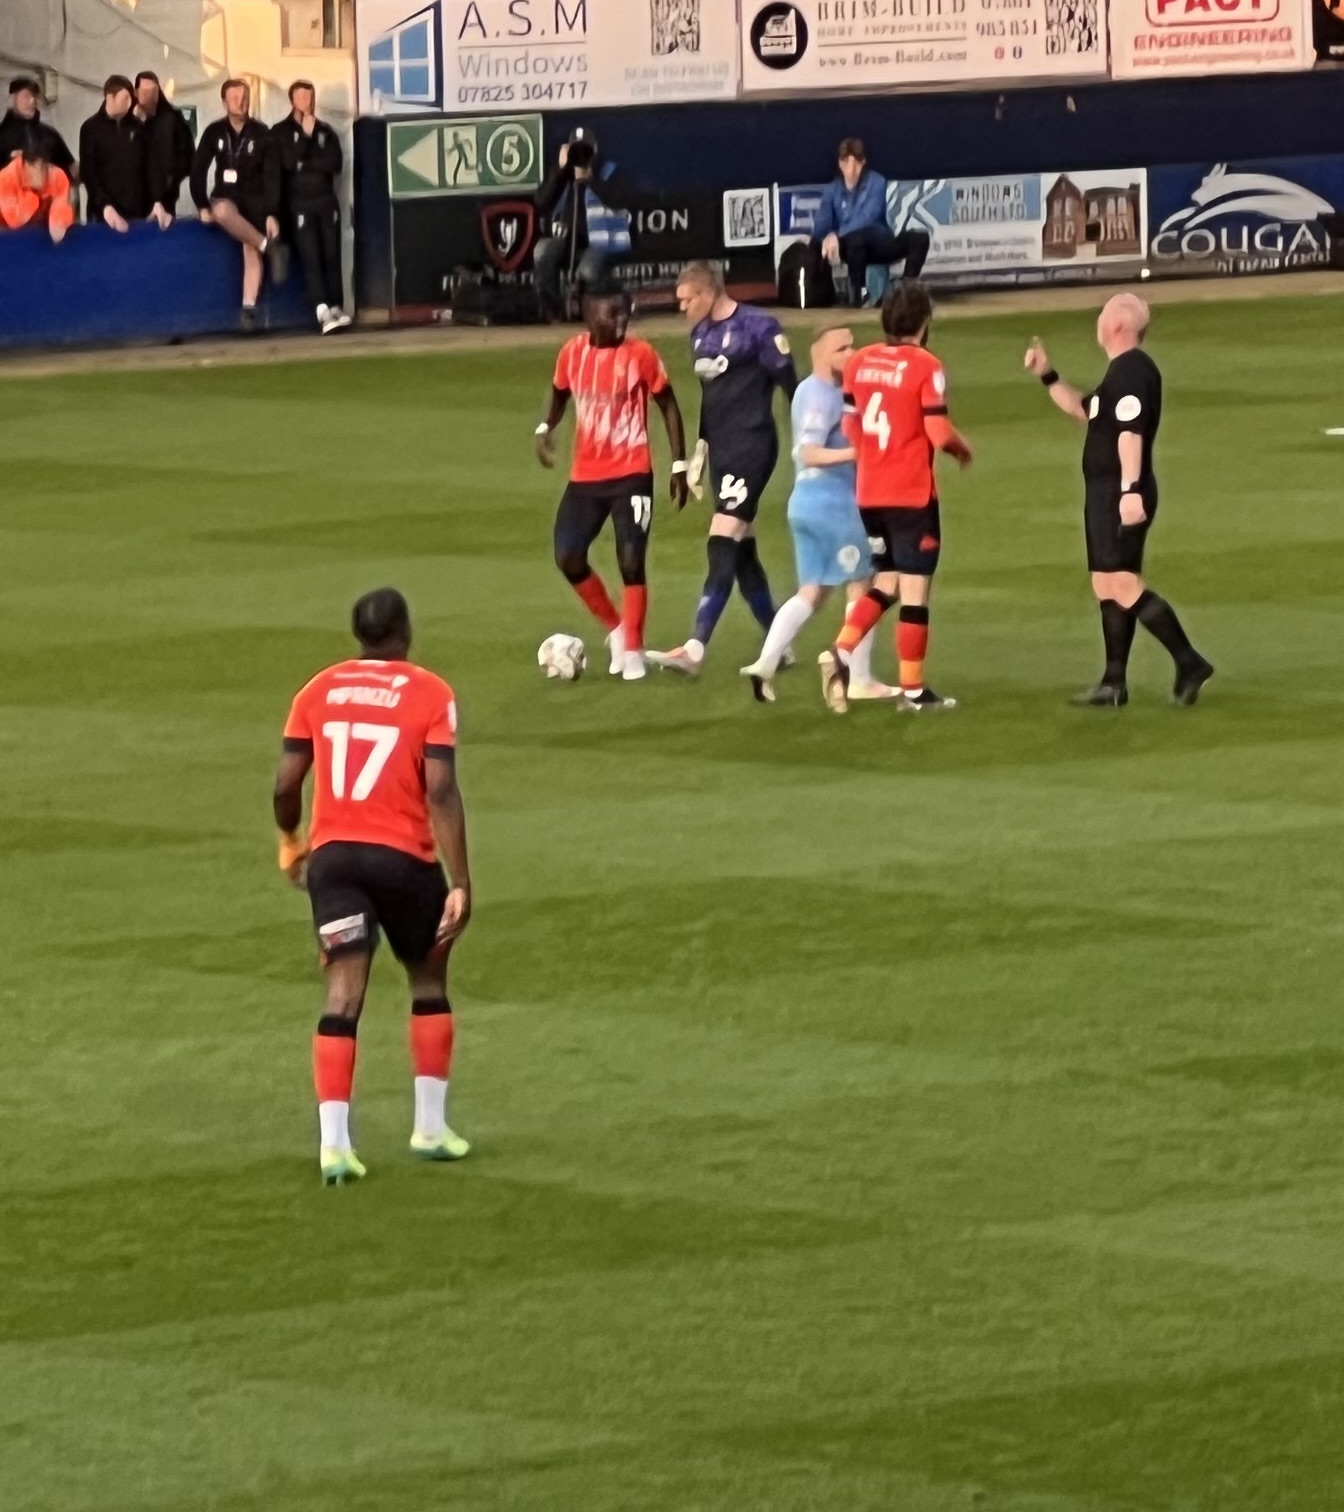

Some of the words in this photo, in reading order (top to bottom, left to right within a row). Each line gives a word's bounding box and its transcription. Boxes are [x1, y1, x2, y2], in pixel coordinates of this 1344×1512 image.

[458, 50, 588, 79] Windows
[501, 136, 522, 172] 5
[1151, 223, 1331, 262] COUGA
[862, 392, 891, 450] 4
[323, 721, 400, 801] 17
